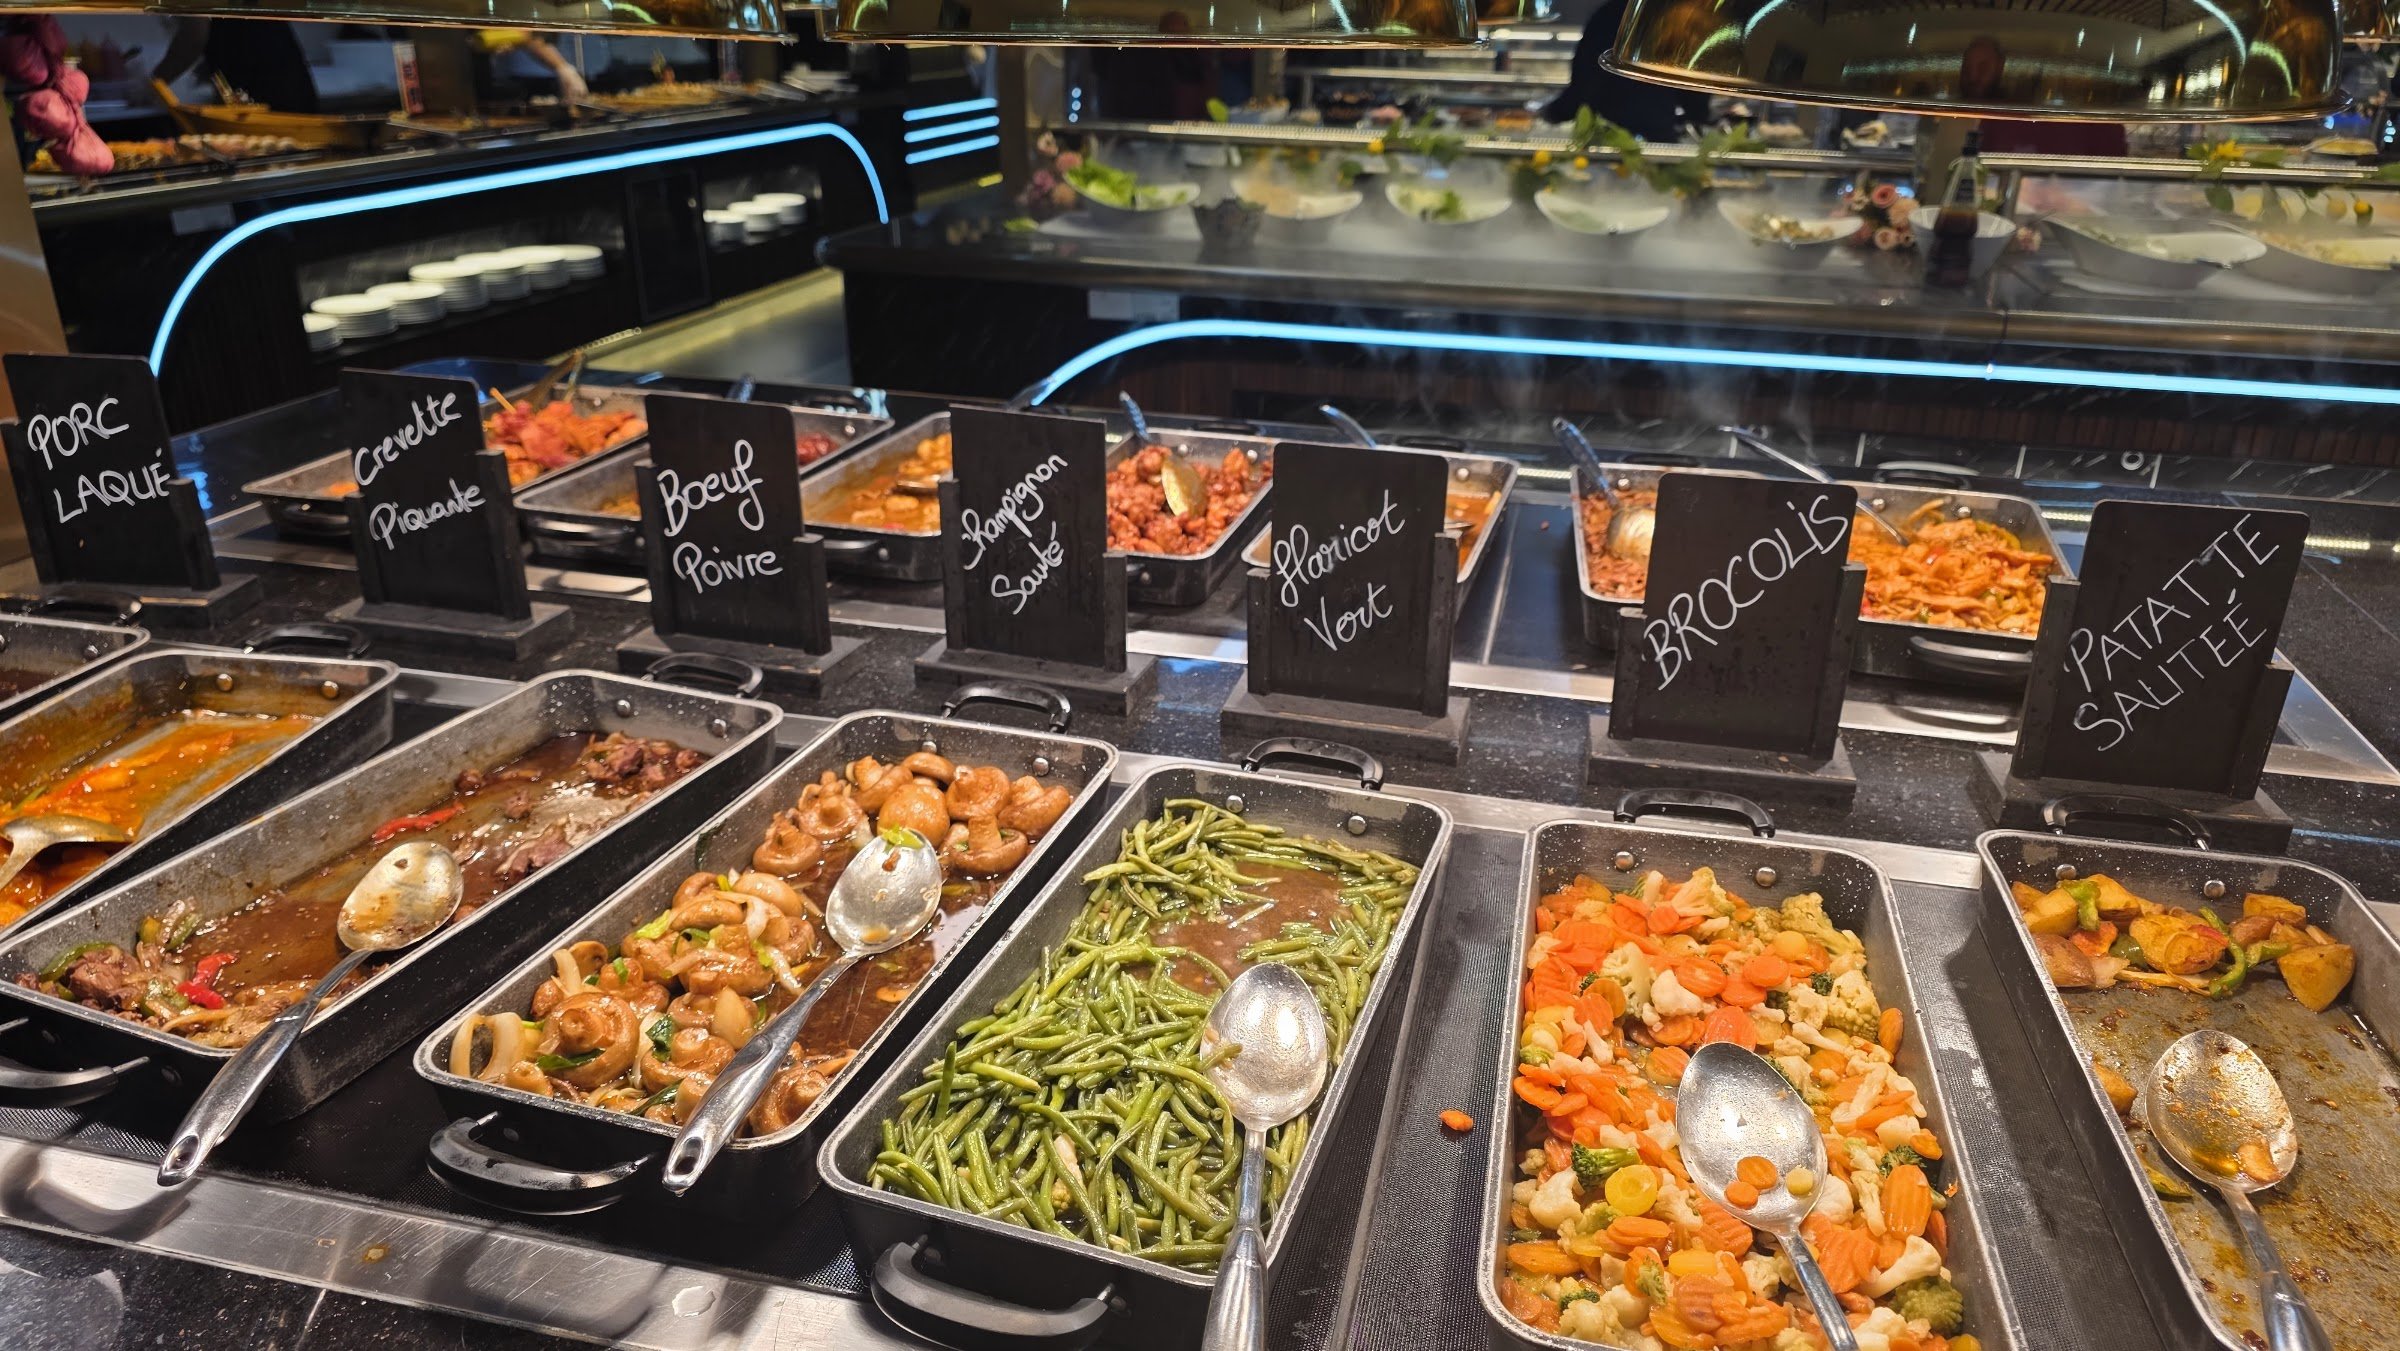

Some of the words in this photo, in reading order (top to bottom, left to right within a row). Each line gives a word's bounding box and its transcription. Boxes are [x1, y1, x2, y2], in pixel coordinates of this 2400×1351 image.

[27, 397, 130, 471] PORC
[354, 391, 462, 486] Crevette
[53, 447, 171, 524] LAQUÉ
[672, 541, 783, 594] Poivre
[990, 520, 1065, 615] Sauté
[1273, 489, 1406, 608] Haricot
[1304, 582, 1393, 652] Vert
[2064, 513, 2280, 693] PATATTE
